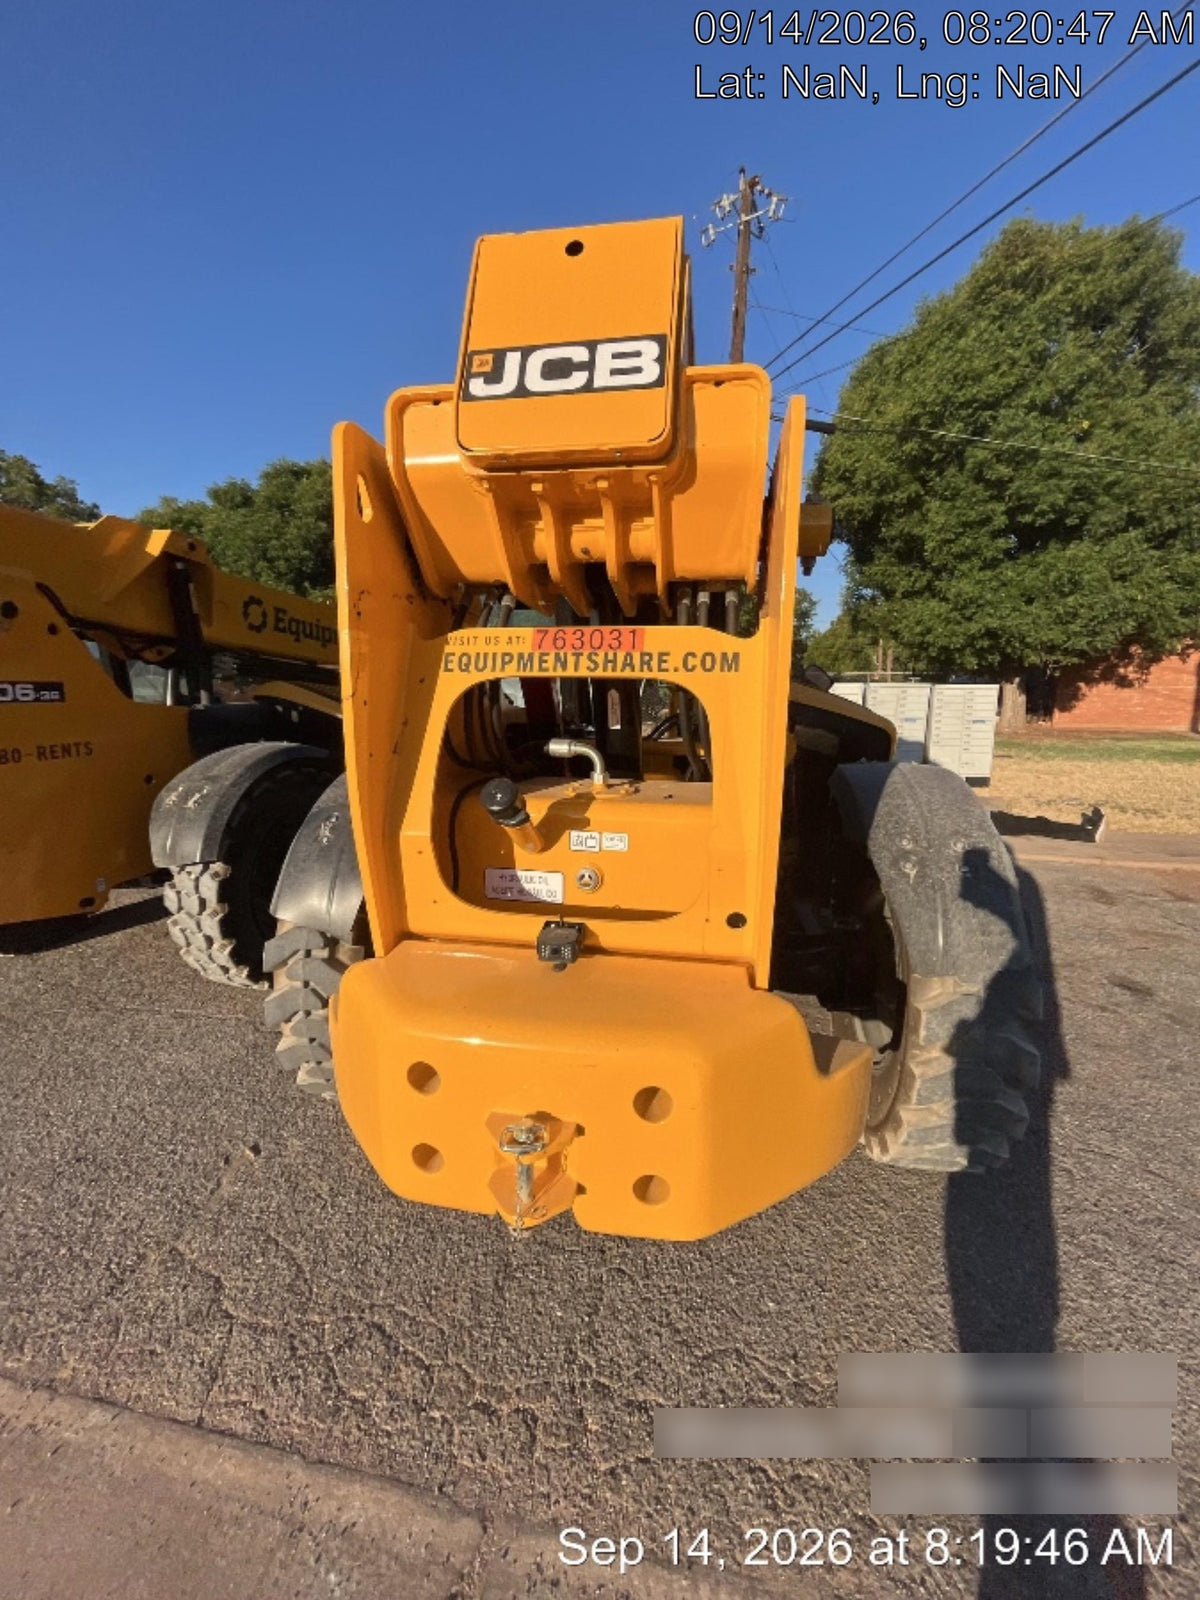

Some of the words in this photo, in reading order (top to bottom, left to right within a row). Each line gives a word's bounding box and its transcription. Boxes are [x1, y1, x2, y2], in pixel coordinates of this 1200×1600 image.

[468, 340, 661, 397] JCB
[484, 635, 500, 646] US
[536, 628, 639, 650] 763031
[443, 651, 740, 674] EQUIPMENTSHARE.COM
